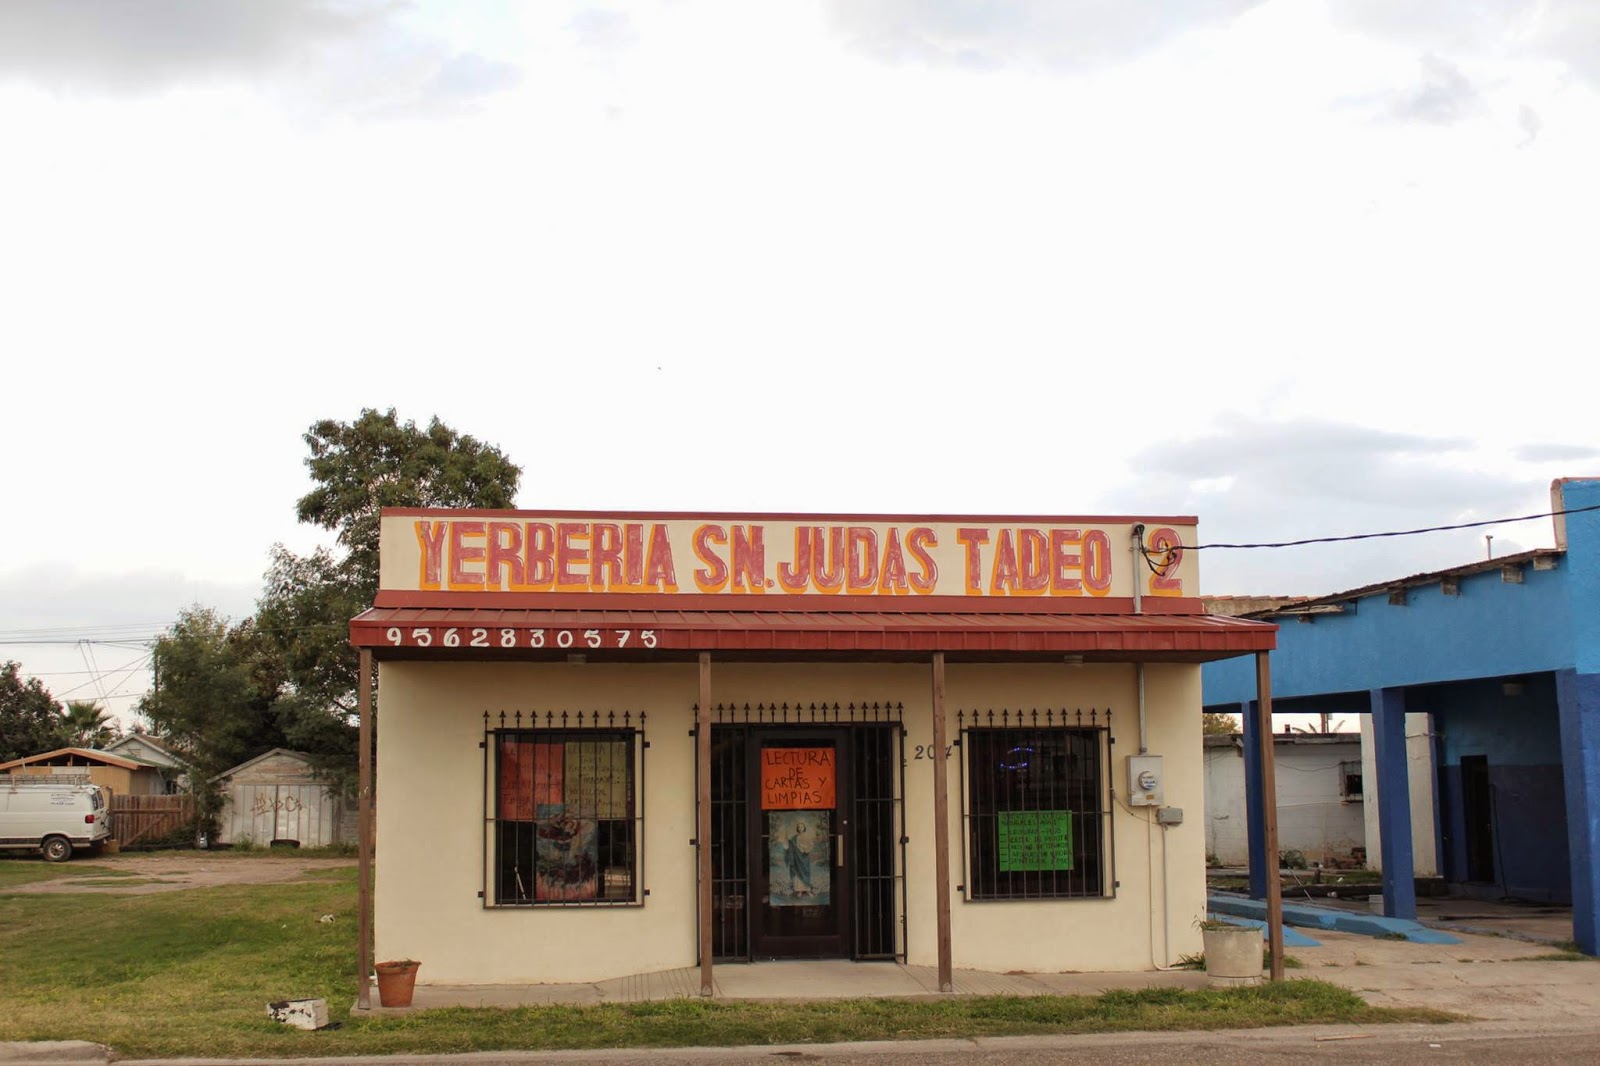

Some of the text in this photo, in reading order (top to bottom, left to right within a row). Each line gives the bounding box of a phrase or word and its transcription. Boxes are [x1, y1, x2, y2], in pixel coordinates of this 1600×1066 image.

[414, 520, 679, 593] YERBERIA
[777, 525, 939, 595] JUDAS
[956, 527, 1112, 596] TADEO
[1148, 527, 1183, 596] 2
[386, 627, 658, 649] 9562830575
[766, 750, 831, 767] LECTURA
[788, 767, 804, 780] DE
[765, 776, 827, 790] CARTAS Y
[767, 790, 822, 805] LIMPIAS
